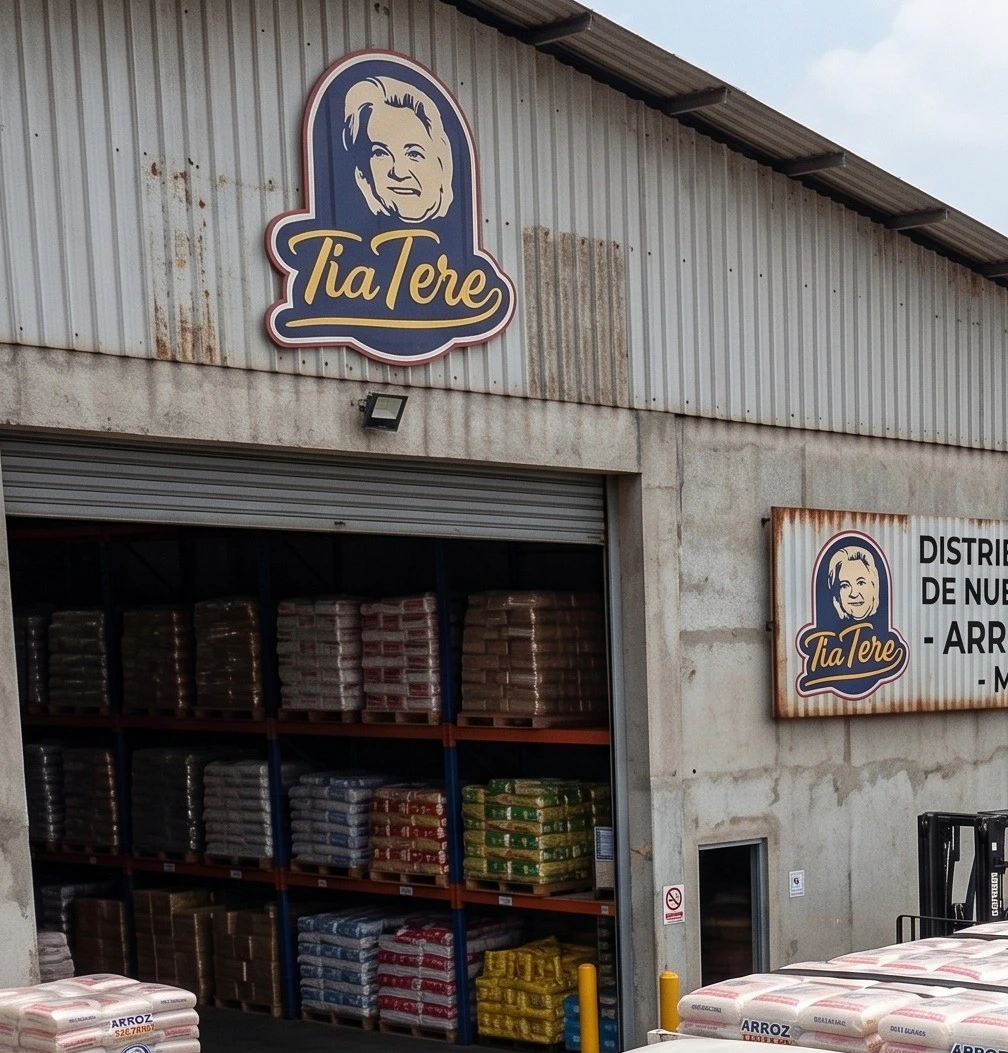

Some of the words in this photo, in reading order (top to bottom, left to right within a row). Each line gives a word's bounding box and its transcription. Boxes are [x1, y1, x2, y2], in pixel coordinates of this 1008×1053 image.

[288, 228, 381, 305] Tia
[370, 228, 503, 312] Tere
[921, 577, 956, 605] DE
[841, 622, 903, 664] Tere
[111, 1013, 153, 1030] ARROZ
[741, 1019, 790, 1038] ARROZ
